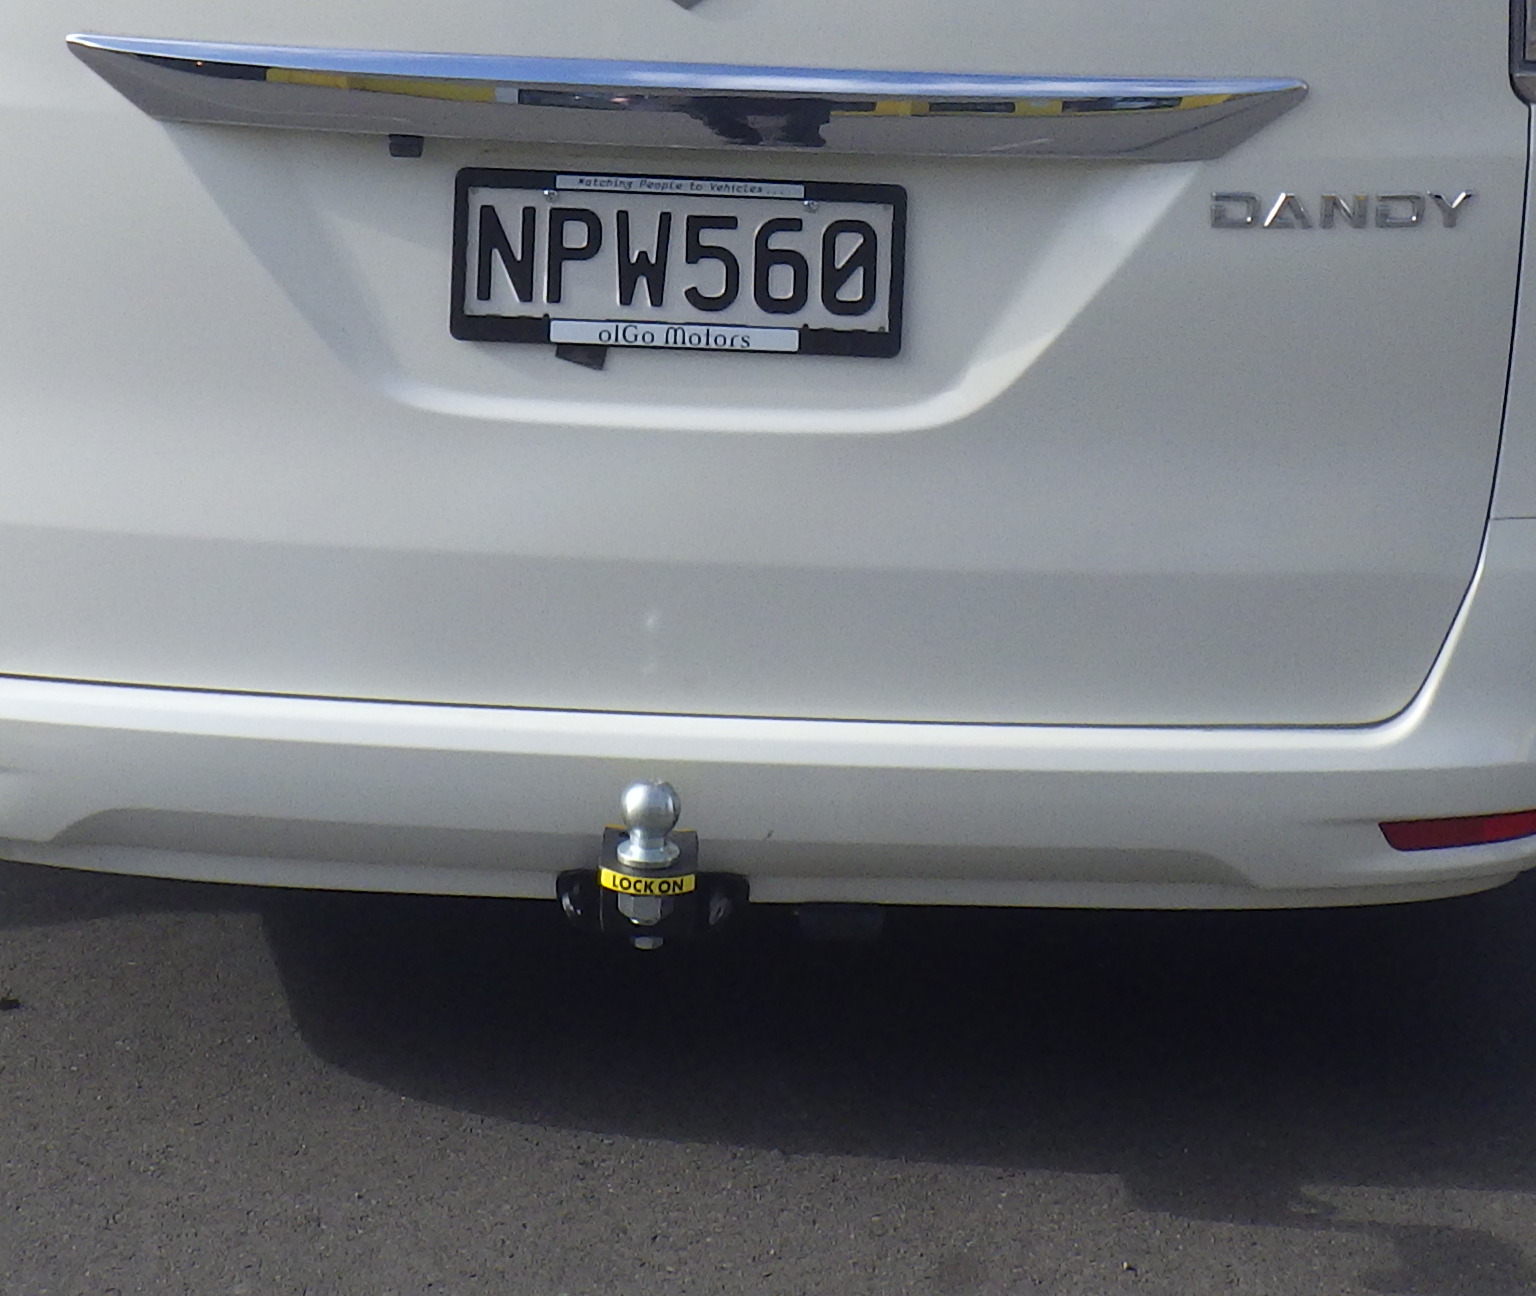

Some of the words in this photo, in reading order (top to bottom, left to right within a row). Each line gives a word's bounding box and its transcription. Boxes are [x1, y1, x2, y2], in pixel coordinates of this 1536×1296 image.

[639, 179, 683, 193] People
[689, 181, 704, 193] to
[1209, 189, 1475, 230] DANDY
[475, 203, 879, 317] NPW560
[664, 325, 752, 349] Motors
[611, 874, 654, 894] LOCK
[658, 878, 685, 895] ON
